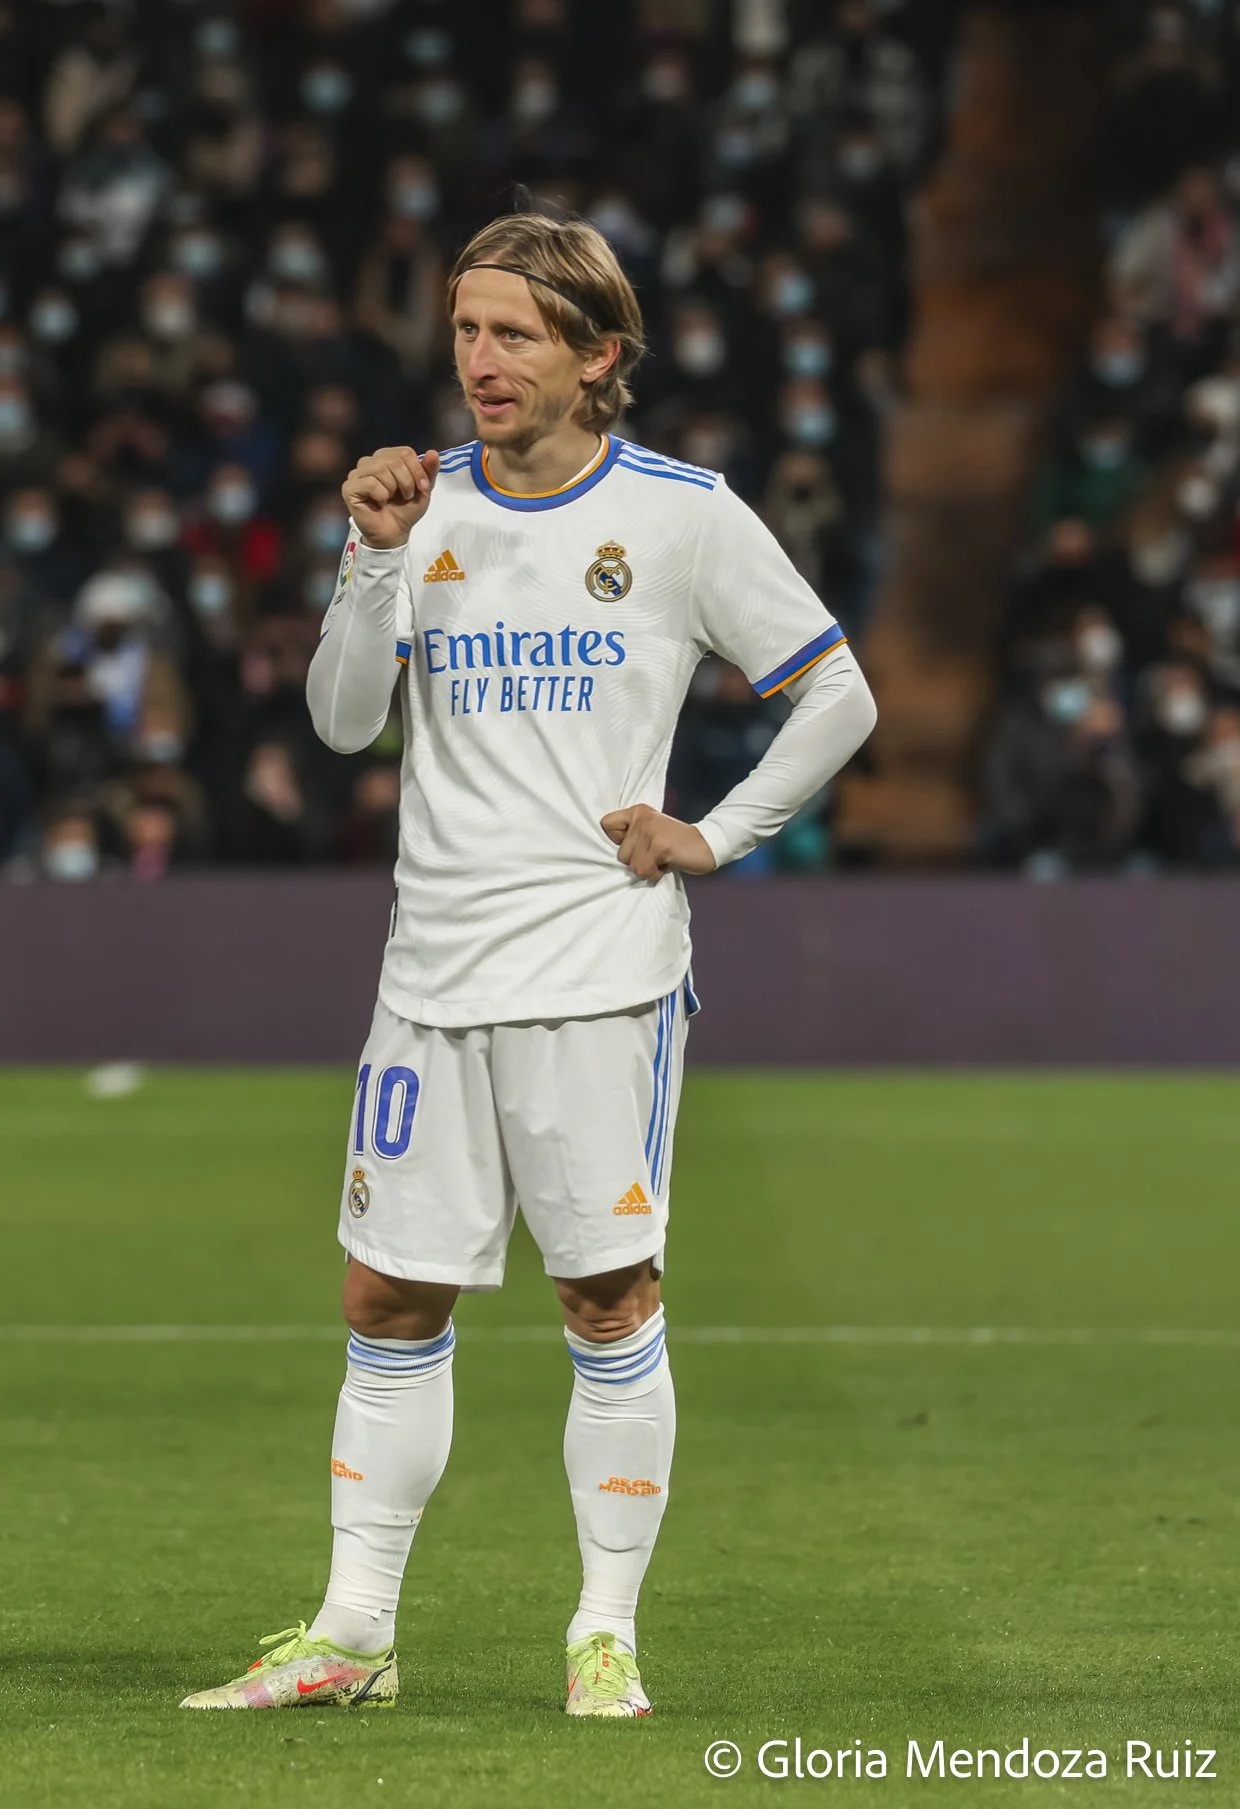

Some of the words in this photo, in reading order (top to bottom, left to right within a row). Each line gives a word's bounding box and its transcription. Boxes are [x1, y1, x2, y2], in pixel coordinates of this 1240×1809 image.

[423, 569, 465, 583] adidas
[423, 621, 626, 674] Emirates
[451, 677, 490, 716] FLY
[500, 676, 594, 713] BETTER
[354, 1064, 421, 1160] 10
[613, 1203, 652, 1216] adidas
